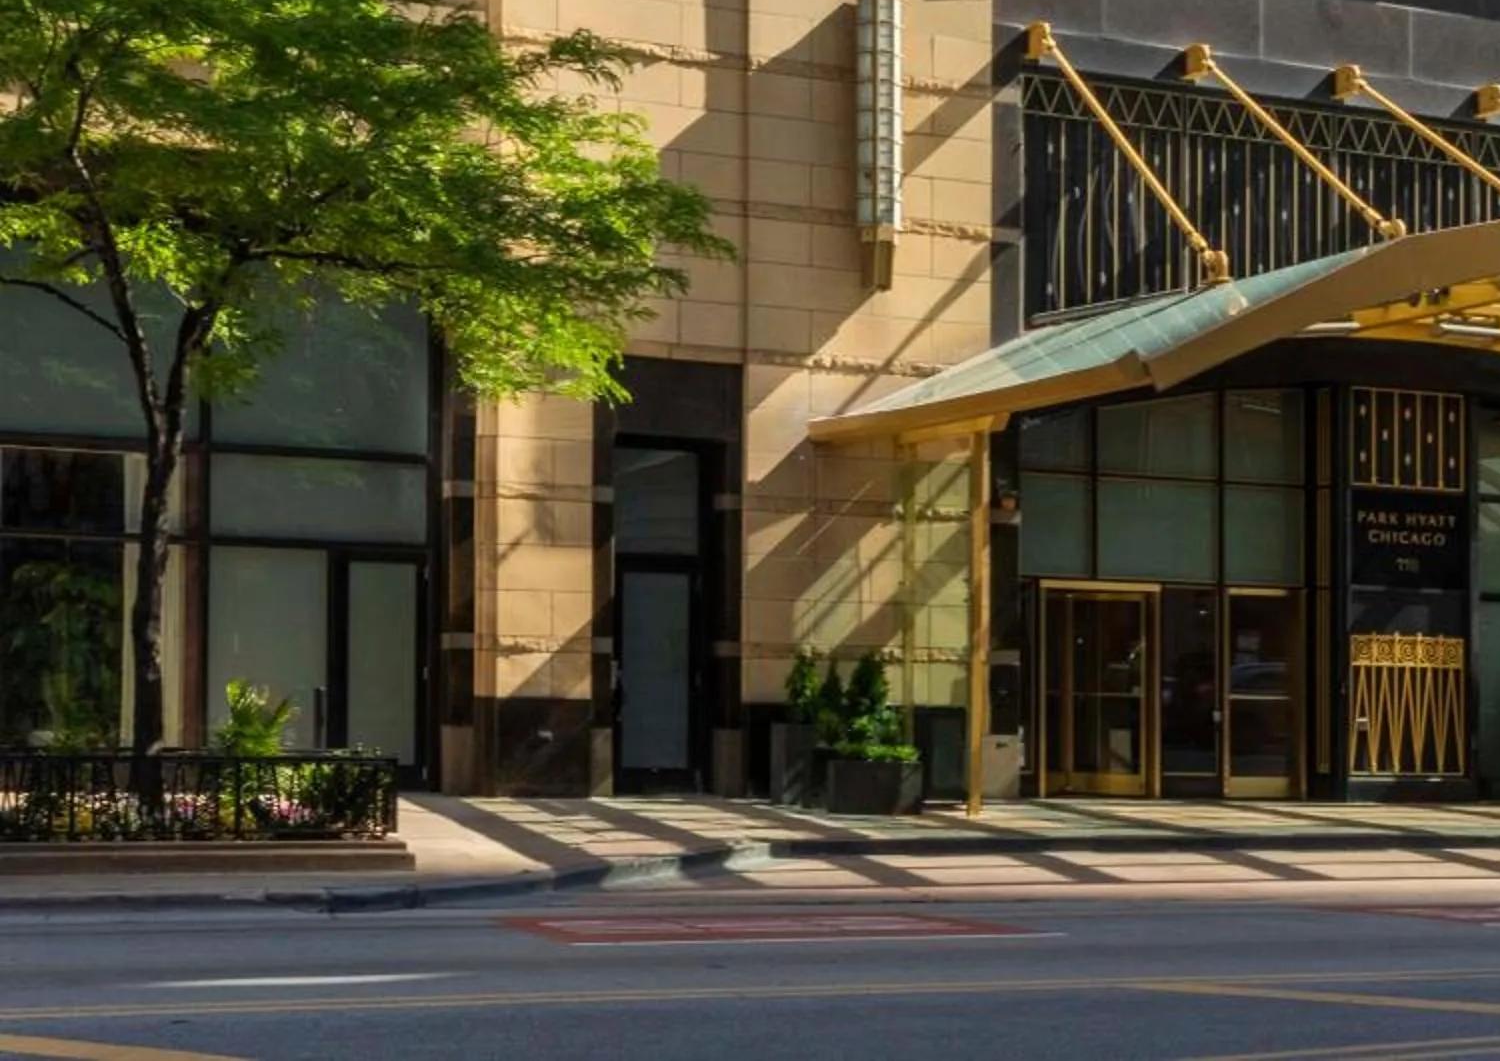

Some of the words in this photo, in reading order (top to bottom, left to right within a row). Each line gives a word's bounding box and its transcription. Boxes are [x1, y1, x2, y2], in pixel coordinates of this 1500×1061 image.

[1357, 510, 1399, 525] PARK
[1405, 514, 1457, 529] HYATT
[1368, 529, 1447, 547] CHICAGO
